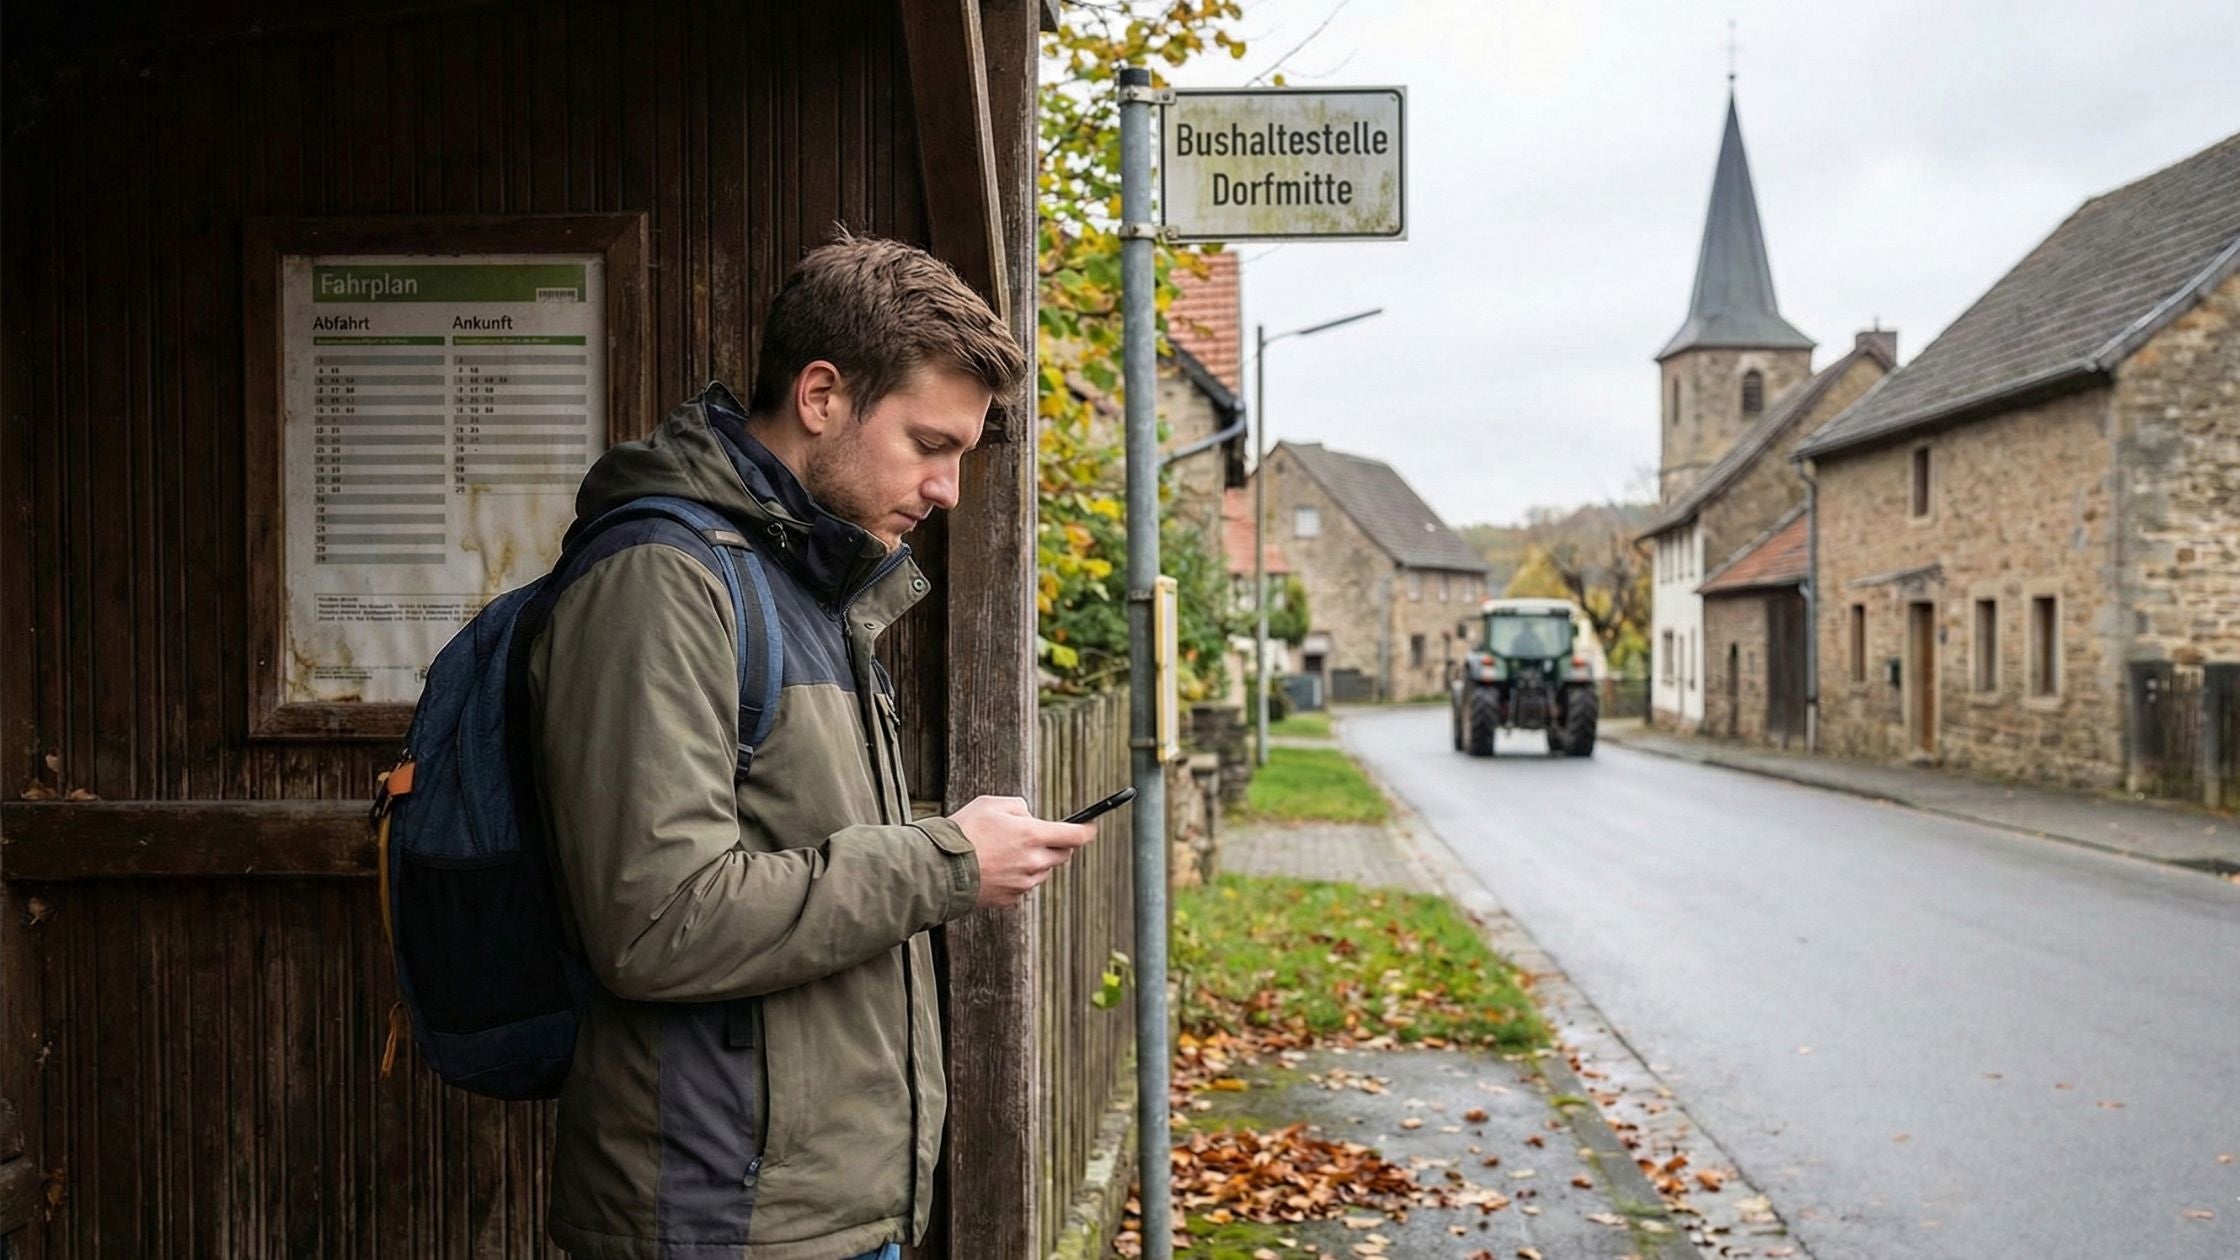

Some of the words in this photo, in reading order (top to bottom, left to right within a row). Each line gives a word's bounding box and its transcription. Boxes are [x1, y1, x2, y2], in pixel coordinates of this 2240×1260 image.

[1176, 121, 1388, 156] Bushaltestelle
[1212, 171, 1353, 206] Dorfmitte
[321, 273, 418, 299] Fahrplan
[313, 316, 370, 330] Abfahrt
[453, 316, 513, 330] Ankunft
